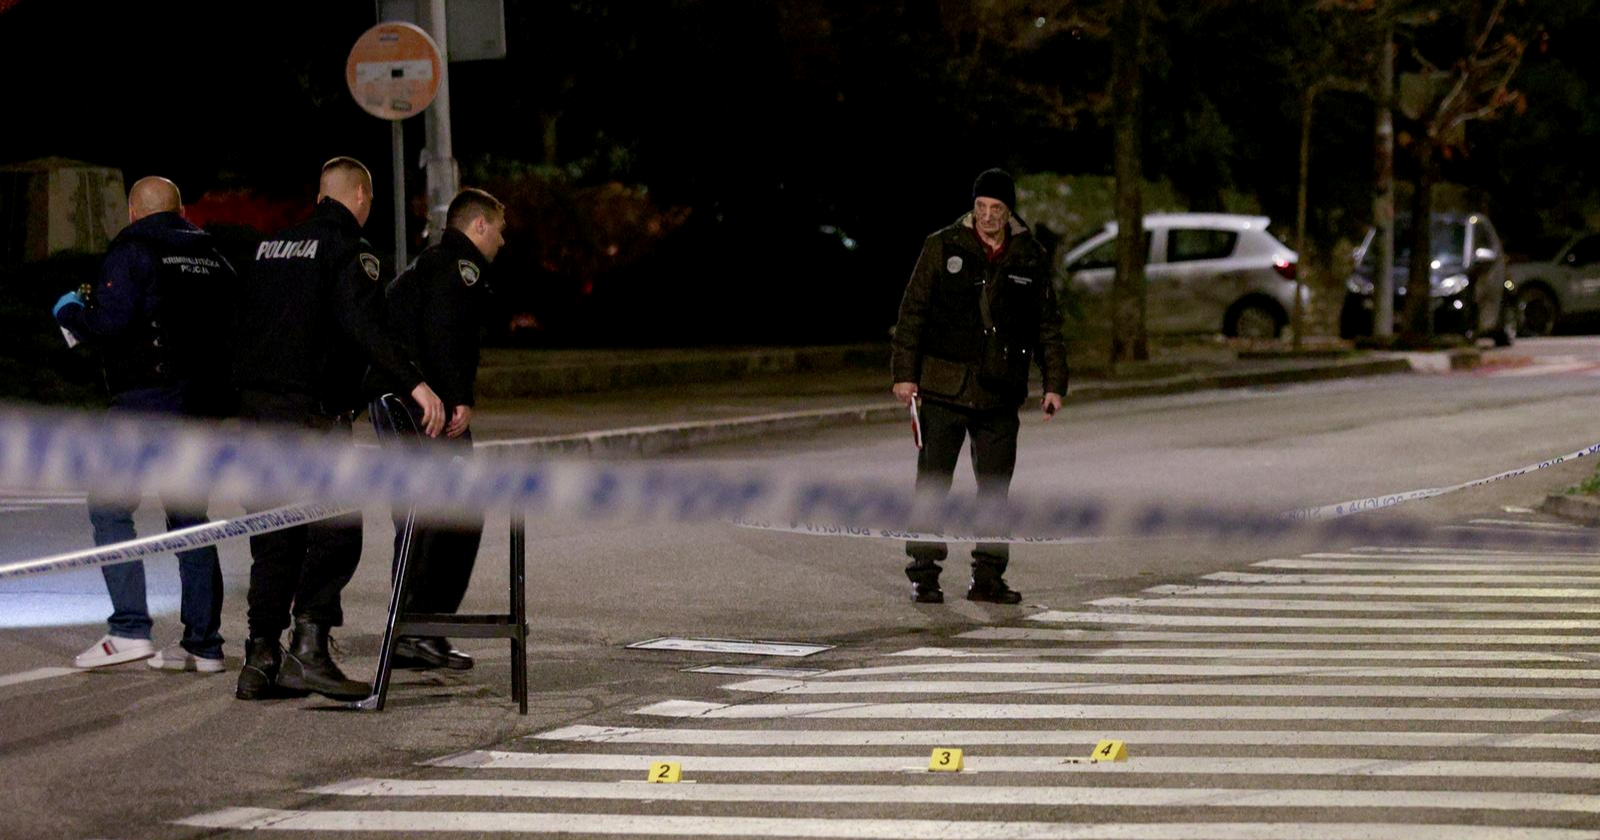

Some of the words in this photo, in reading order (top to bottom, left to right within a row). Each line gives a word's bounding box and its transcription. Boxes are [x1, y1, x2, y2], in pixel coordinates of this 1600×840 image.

[225, 521, 248, 537] STOP
[245, 513, 285, 532] POLICIJA
[1101, 743, 1113, 756] 4
[940, 751, 951, 765] 3
[658, 764, 670, 778] 2
